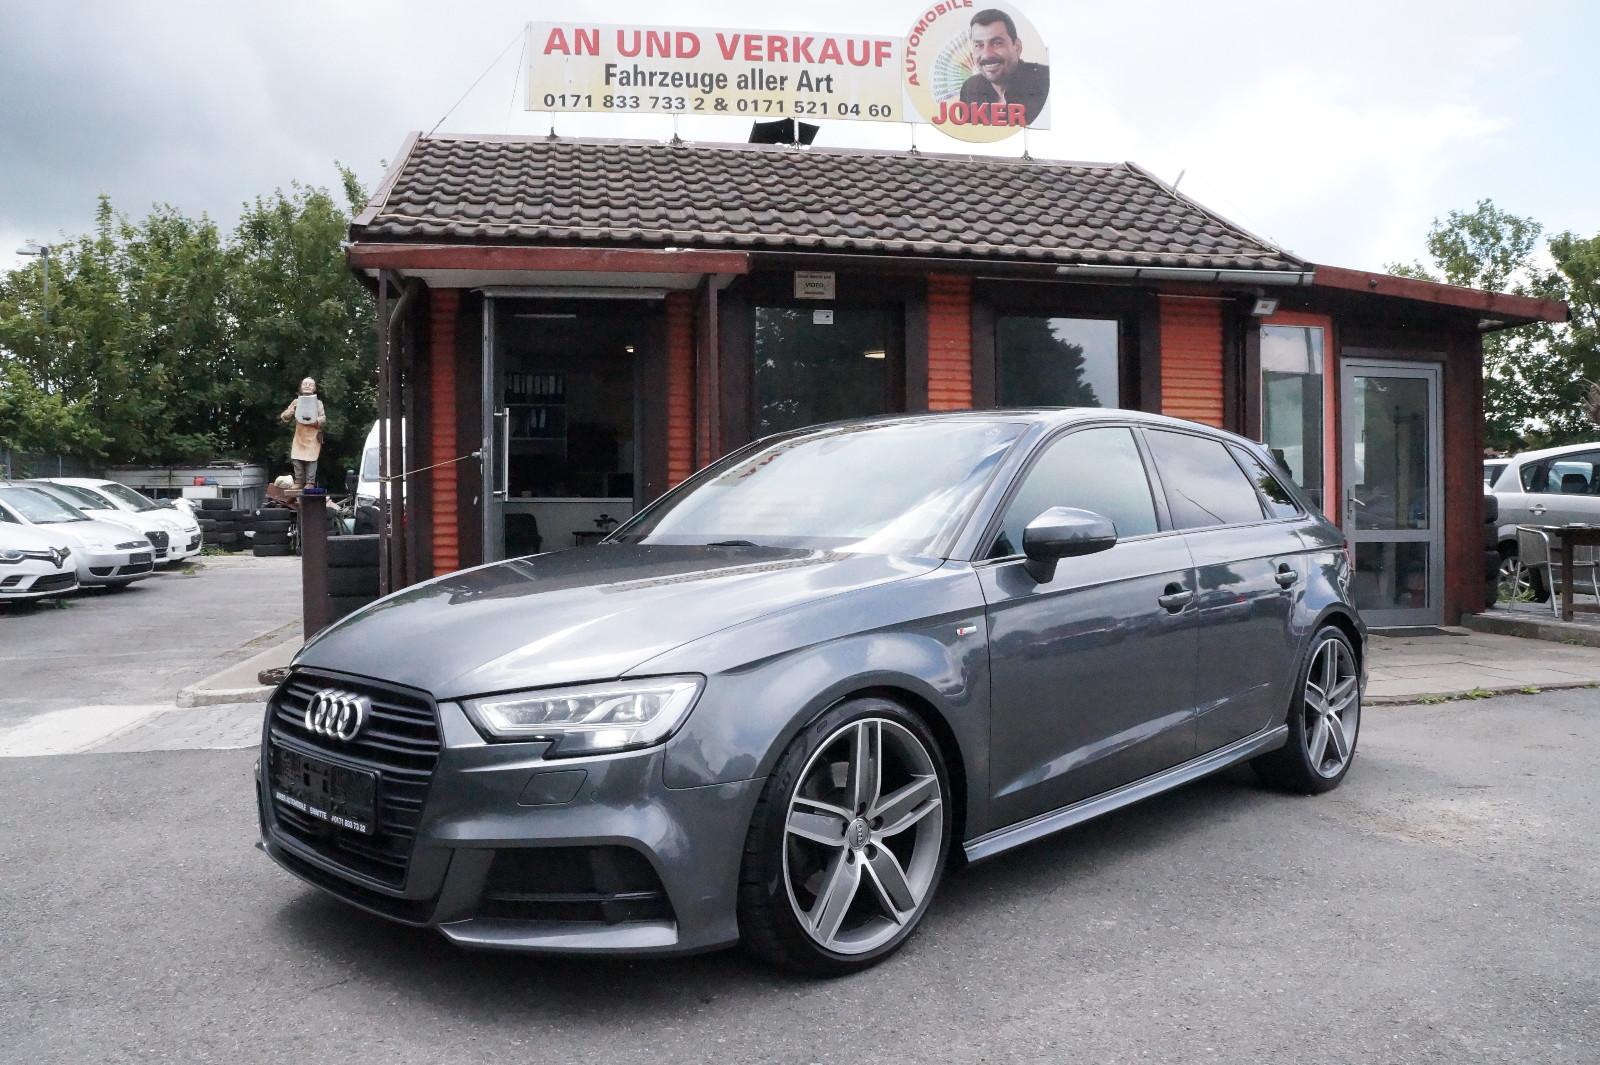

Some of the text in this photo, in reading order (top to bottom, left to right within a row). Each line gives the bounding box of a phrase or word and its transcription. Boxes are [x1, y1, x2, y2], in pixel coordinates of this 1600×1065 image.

[543, 27, 892, 68] AN UND VERKAUF
[905, 0, 973, 86] AUTOMOBILE
[604, 63, 833, 94] Fahrzeuge aller Art
[543, 93, 892, 118] 0171 833 733 2 & 0171 521 04 60
[931, 101, 1027, 128] JOKER
